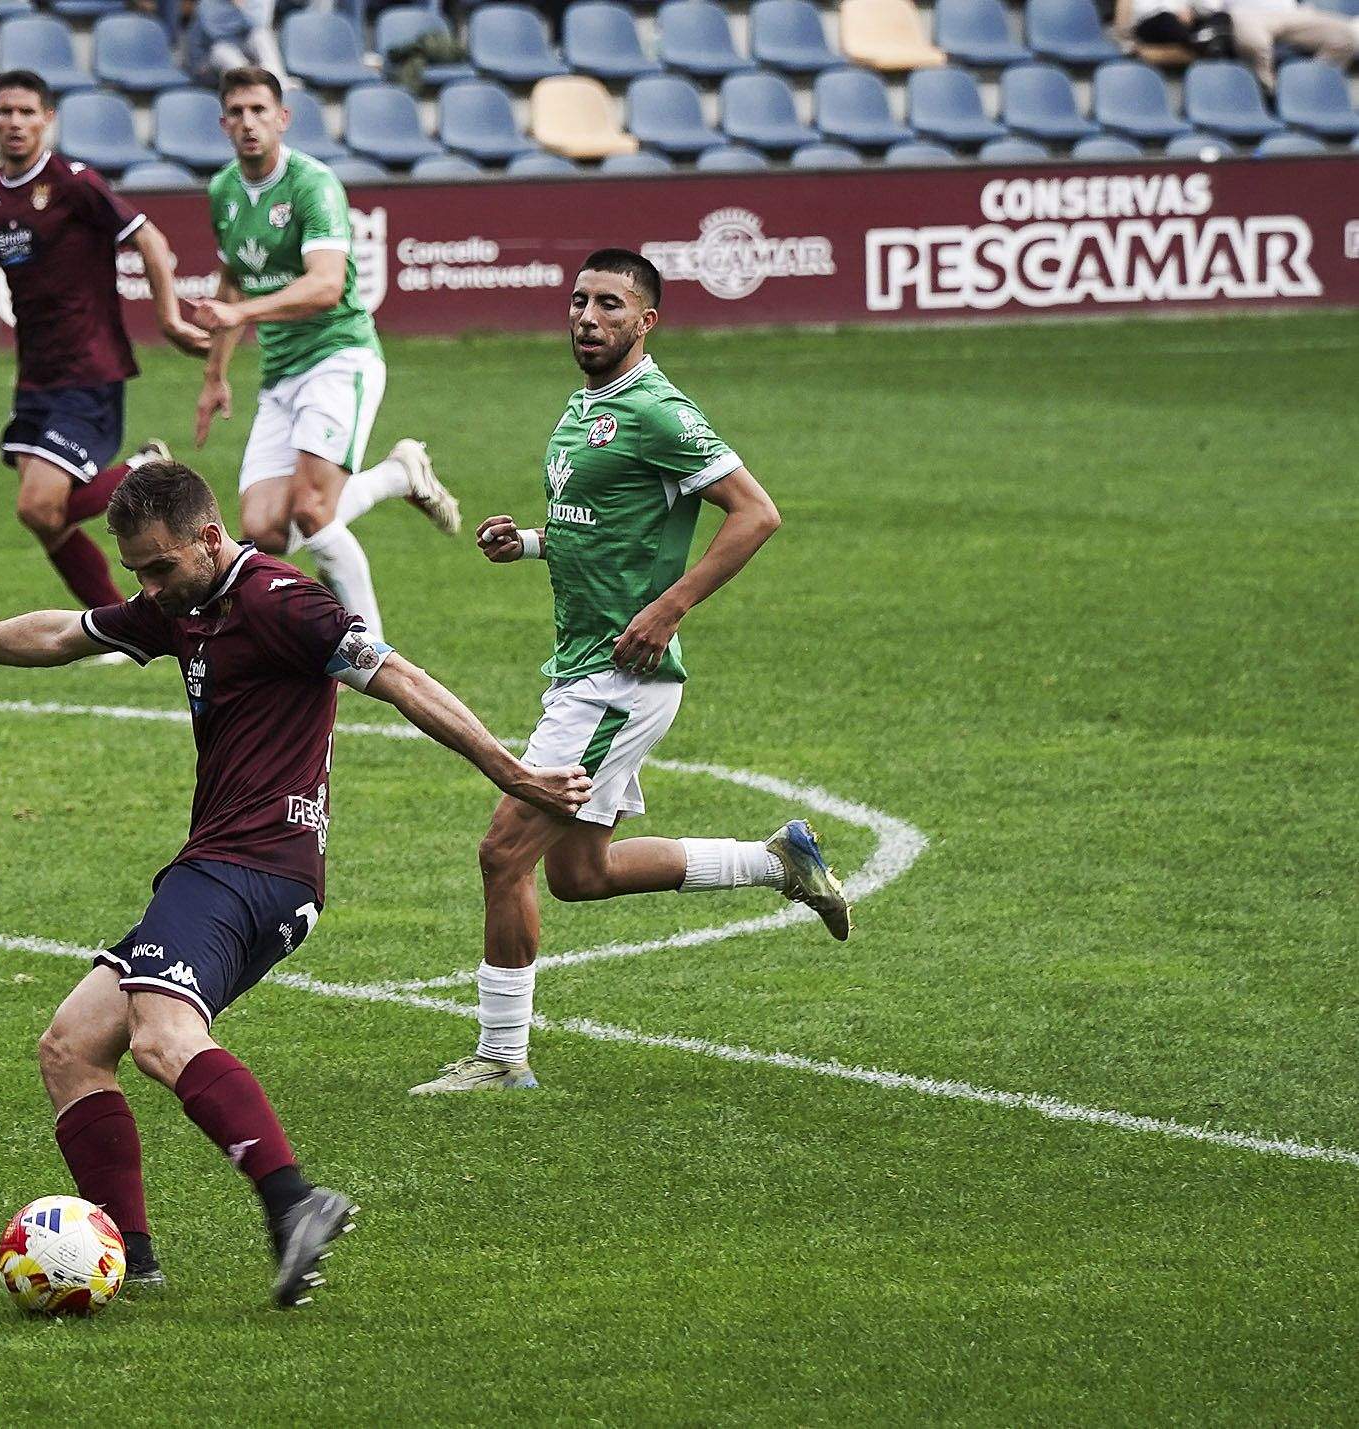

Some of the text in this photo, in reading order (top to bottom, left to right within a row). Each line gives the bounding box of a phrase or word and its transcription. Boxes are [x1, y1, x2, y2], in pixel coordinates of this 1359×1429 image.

[980, 173, 1213, 221] CONSERVAS
[397, 236, 500, 265] Concello
[865, 215, 1323, 311] PESCAMAR
[397, 261, 564, 291] de Pontevedra
